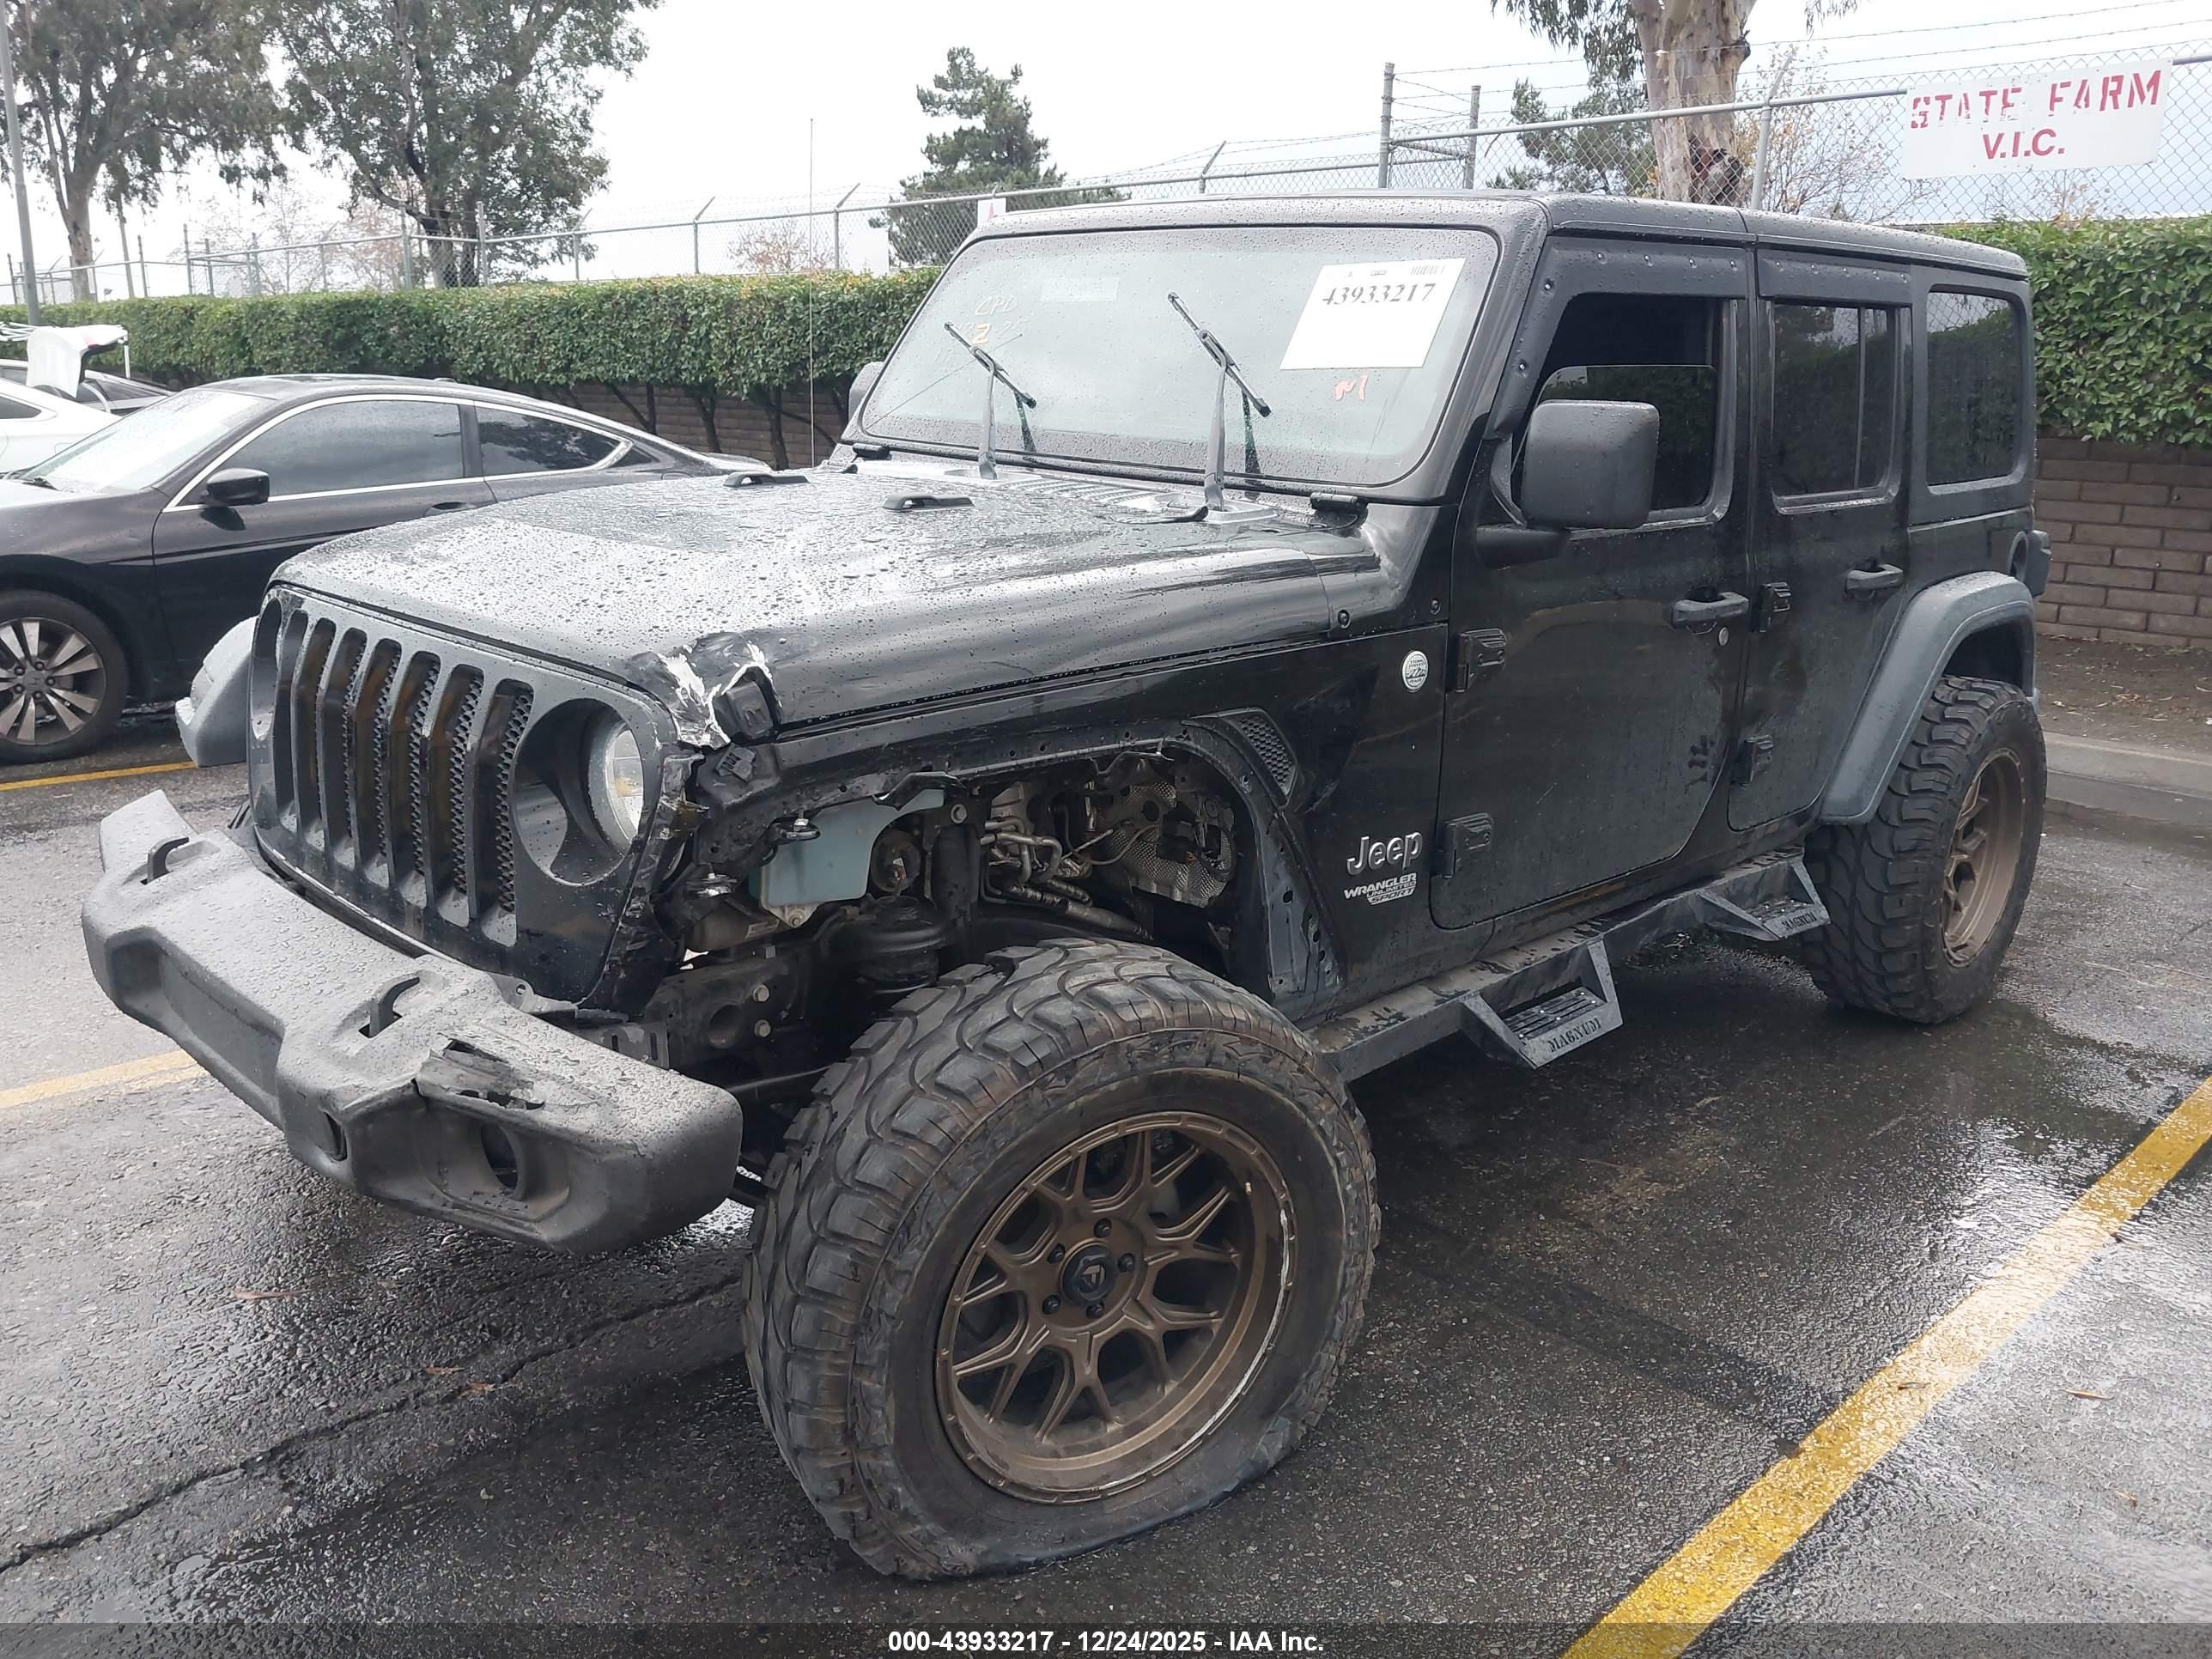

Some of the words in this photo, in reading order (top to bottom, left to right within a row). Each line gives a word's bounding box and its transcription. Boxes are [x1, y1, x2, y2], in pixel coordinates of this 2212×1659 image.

[1911, 87, 2021, 129] STATE
[2048, 70, 2161, 116] FARM
[1982, 129, 2065, 160] V.I.C.
[1322, 283, 1437, 306] 43933217
[1346, 831, 1423, 876] Jeep
[1344, 872, 1417, 900] WRANGLER
[1366, 881, 1417, 898] UNLIMITED
[1370, 887, 1414, 903] SPORT
[1547, 1017, 1601, 1054] MAGNUM
